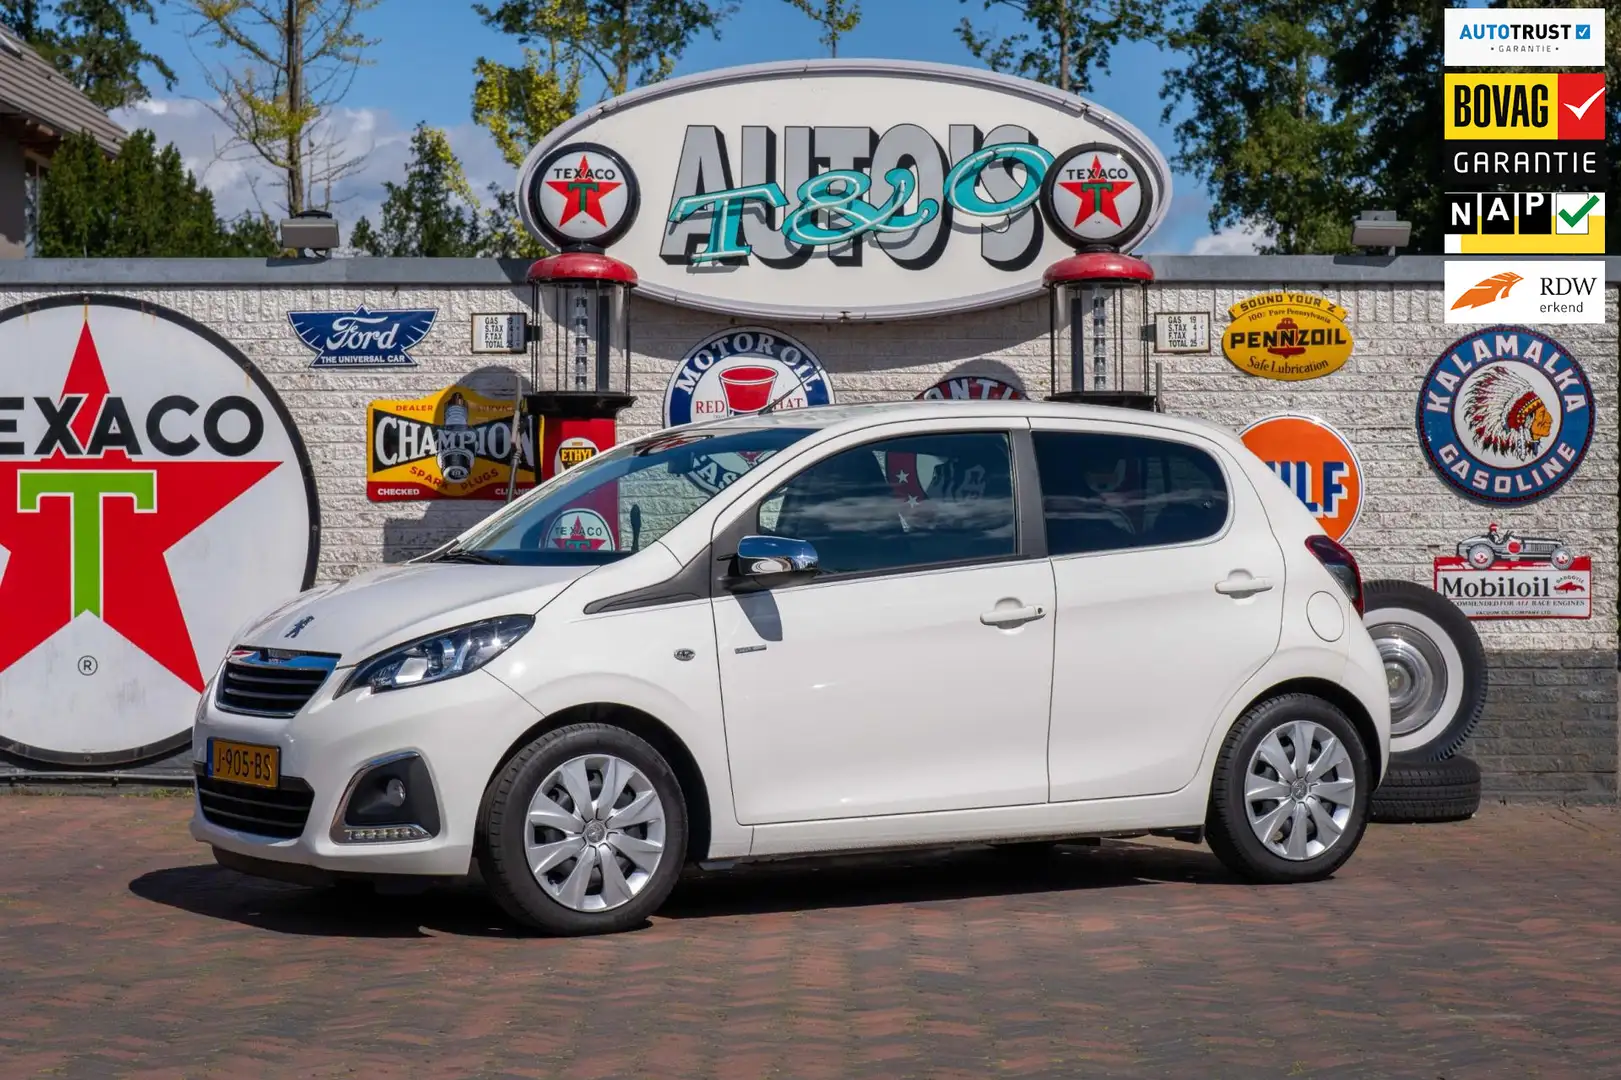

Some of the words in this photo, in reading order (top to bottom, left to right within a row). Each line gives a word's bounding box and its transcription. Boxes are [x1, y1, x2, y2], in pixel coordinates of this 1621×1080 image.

[553, 167, 617, 182] TEXACO
[1066, 167, 1130, 181] TEXACO
[1240, 294, 1283, 313] SOUND
[1288, 294, 1322, 308] YOUR
[1328, 303, 1338, 313] Z
[326, 316, 400, 350] Ford
[1230, 328, 1347, 349] PENNZOIL
[321, 356, 337, 364] THE
[338, 355, 385, 364] UNIVERSAL
[388, 355, 405, 363] CAR
[675, 332, 775, 395] MOTOR
[780, 344, 822, 392] OIL
[1246, 355, 1270, 371] Safe
[1271, 358, 1329, 375] Lubrication
[1426, 335, 1587, 413] KALAMALKA
[695, 400, 725, 414] RED
[773, 397, 804, 411] HAT
[1439, 441, 1577, 494] GASOLINE
[410, 466, 450, 491] SPARK
[460, 467, 499, 491] PLUGS
[377, 488, 420, 496] CHECKED
[555, 527, 602, 536] TEXACO
[1442, 577, 1550, 598] Mobiloil
[215, 747, 271, 781] J-905-BS
